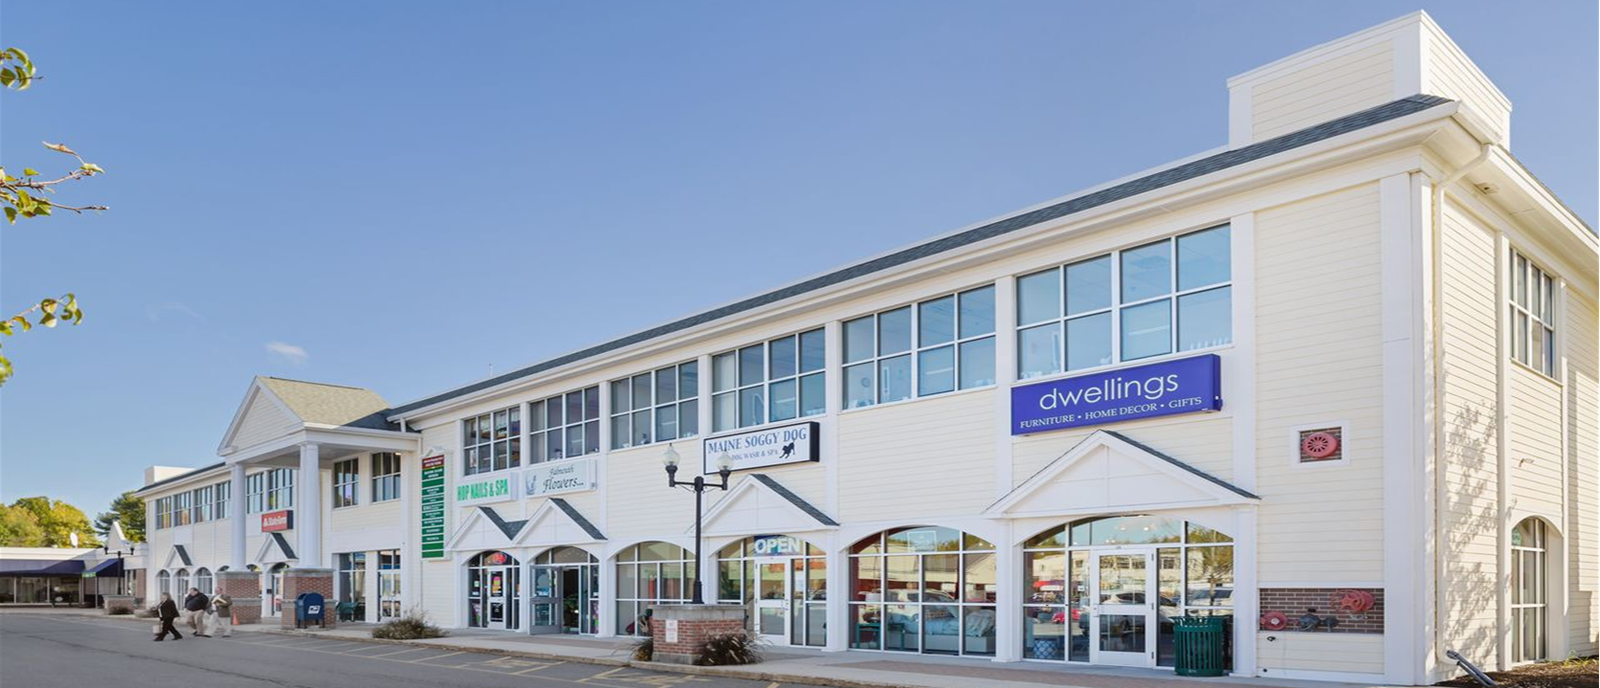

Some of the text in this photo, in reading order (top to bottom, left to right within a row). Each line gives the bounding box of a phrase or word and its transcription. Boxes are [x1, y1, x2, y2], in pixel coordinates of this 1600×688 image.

[1039, 374, 1179, 411] dwellings
[1020, 396, 1202, 429] FURNITURE HOME DECOR GIFTS
[708, 427, 807, 454] MAINE SOGGY DOG
[744, 451, 760, 459] WASH
[470, 481, 488, 500] NAILS
[489, 482, 494, 497] &
[495, 478, 509, 496] SPA
[755, 537, 800, 554] OPEN
